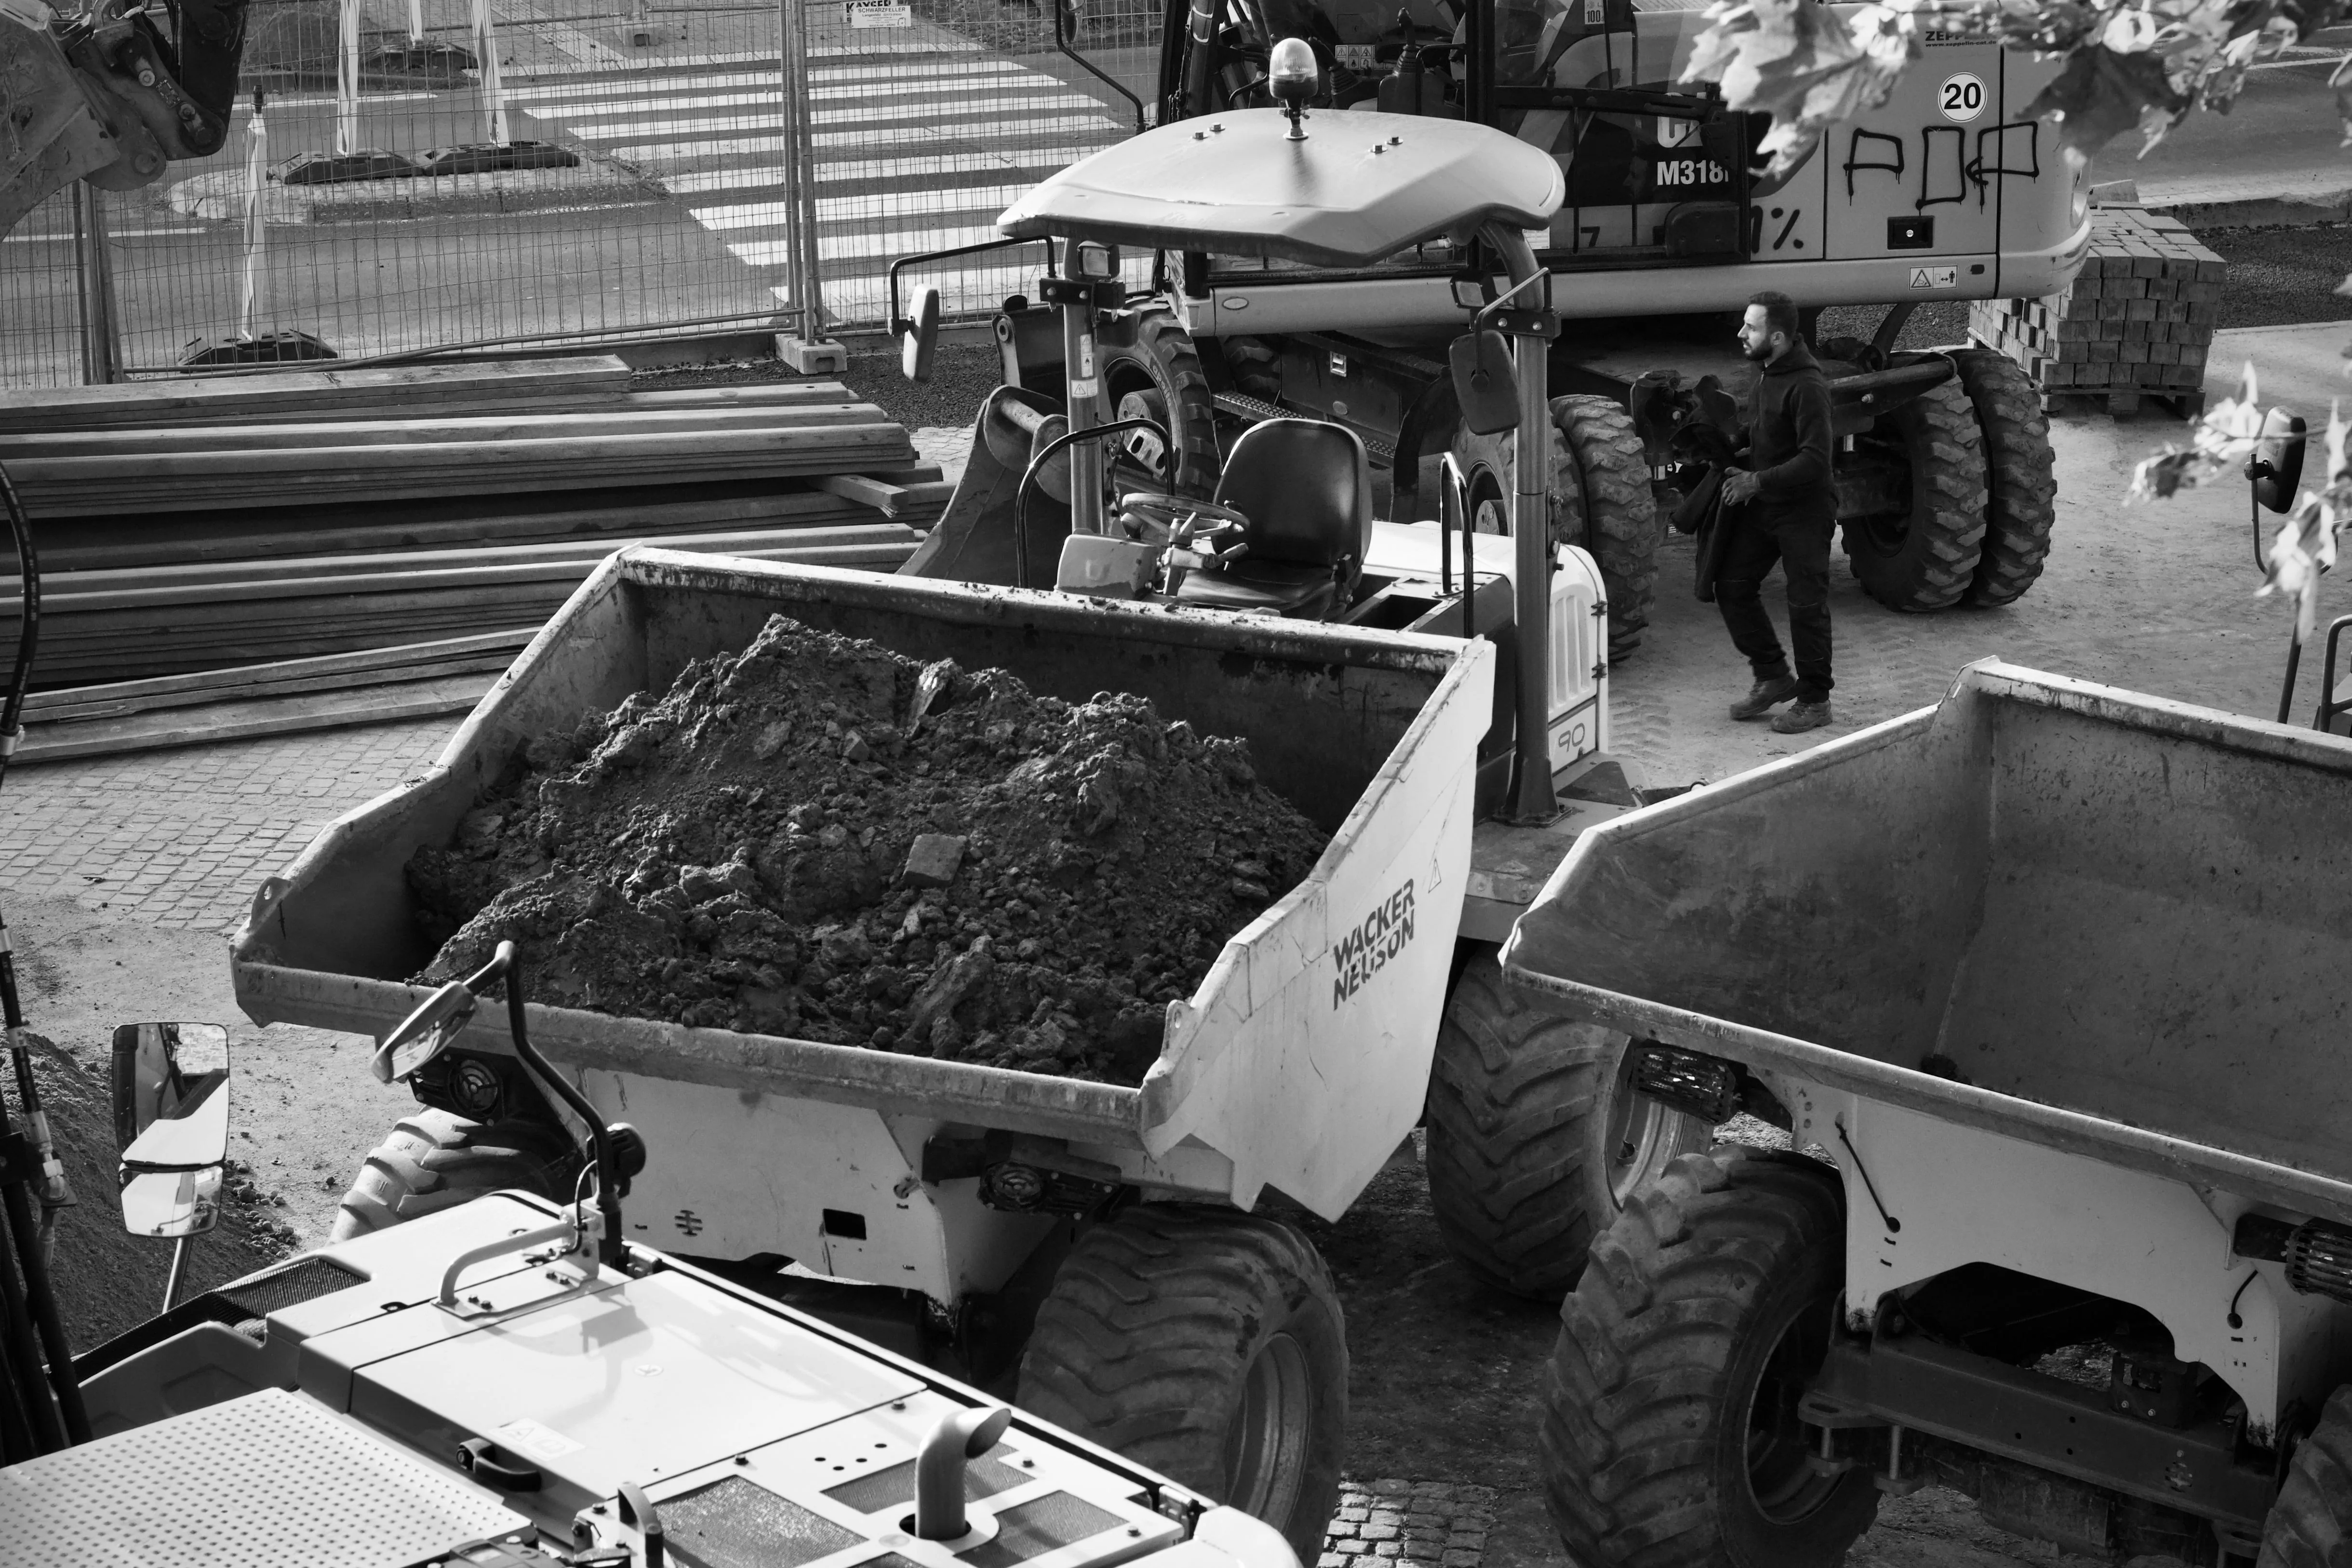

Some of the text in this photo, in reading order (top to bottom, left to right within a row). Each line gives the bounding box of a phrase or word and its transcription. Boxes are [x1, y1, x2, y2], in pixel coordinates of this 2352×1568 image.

[1587, 10, 1601, 23] 100
[1943, 82, 1981, 109] 20
[1558, 723, 1585, 752] 90
[1334, 878, 1415, 974] WACKER
[1333, 908, 1415, 1012] NEUSON
